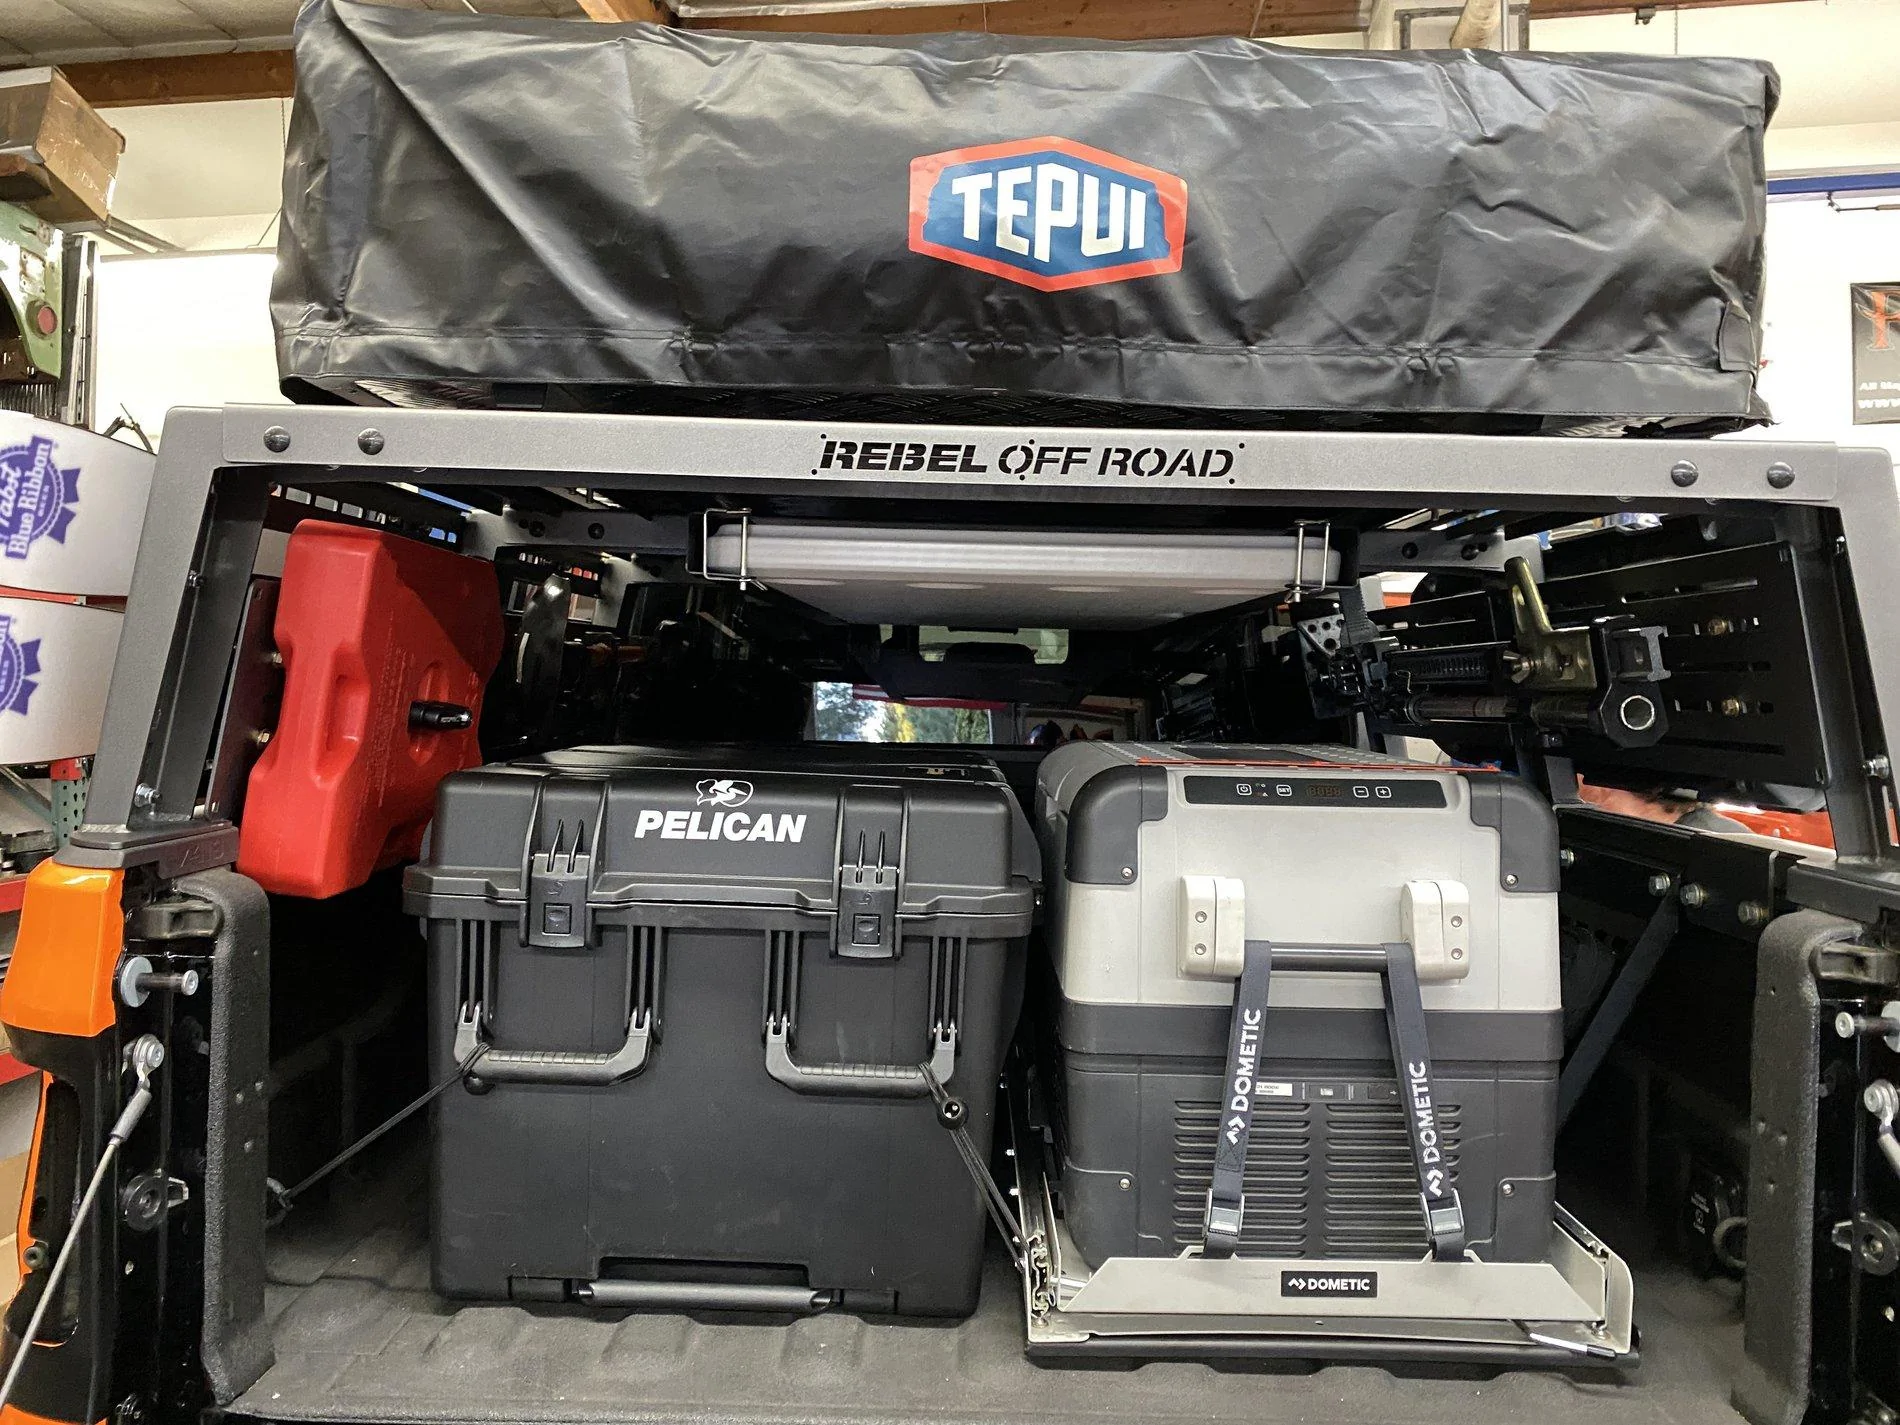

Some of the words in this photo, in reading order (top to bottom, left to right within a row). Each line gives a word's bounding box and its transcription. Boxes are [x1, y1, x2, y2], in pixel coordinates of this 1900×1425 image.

[951, 162, 1147, 263] TEPUI
[17, 443, 50, 511] Ribbon
[819, 440, 988, 474] REBEL
[999, 444, 1091, 477] OFF
[1097, 447, 1235, 478] ROAD
[8, 512, 35, 556] Blue
[634, 810, 807, 843] PELICAN
[1230, 1008, 1261, 1112] DOMETIC
[1409, 1061, 1440, 1164] DOMETIC
[1307, 1278, 1371, 1291] DOMETIC
